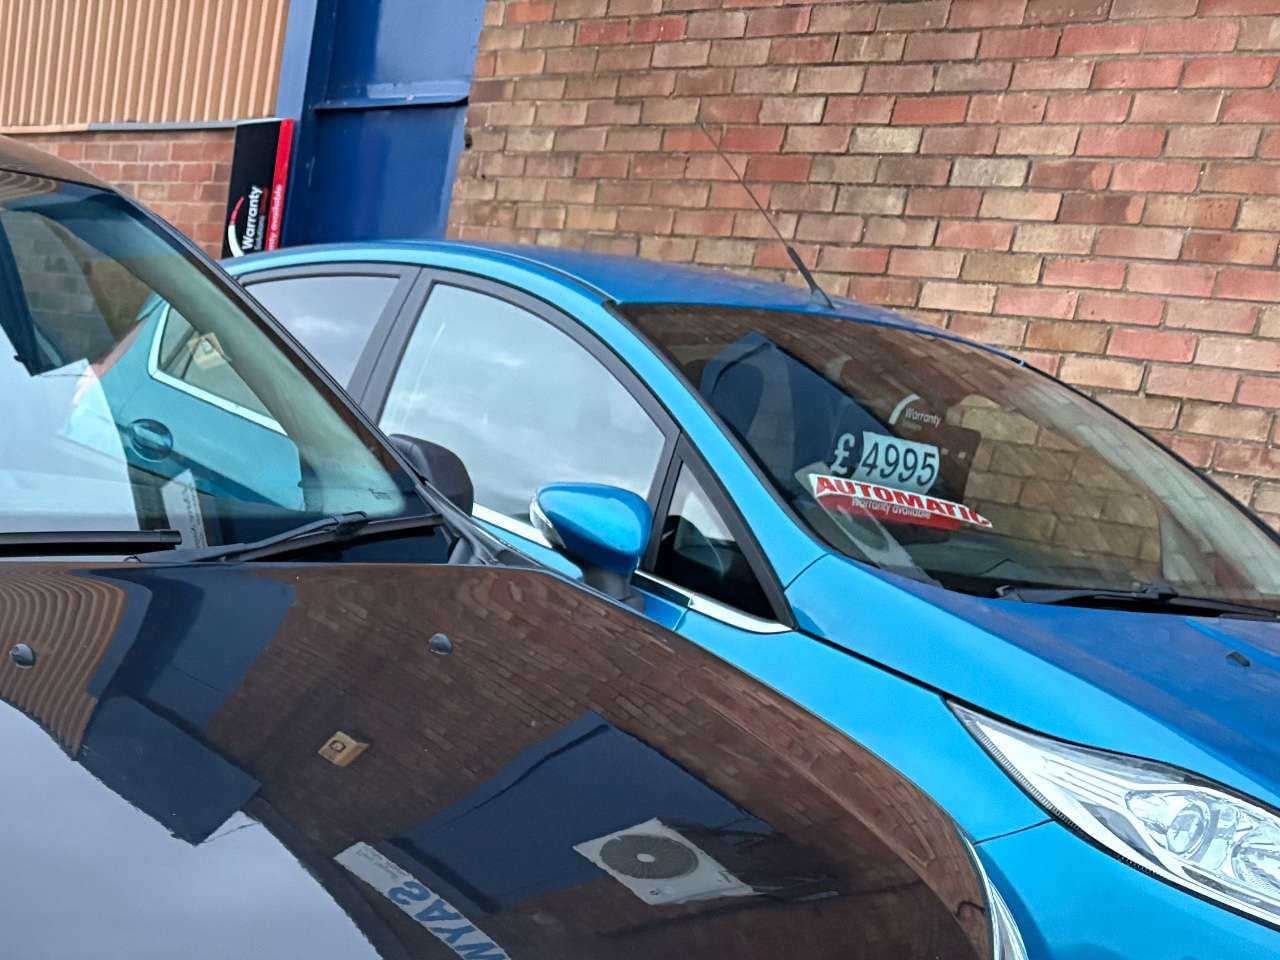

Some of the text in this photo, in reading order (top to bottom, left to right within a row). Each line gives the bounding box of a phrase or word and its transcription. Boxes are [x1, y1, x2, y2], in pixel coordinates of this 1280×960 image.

[241, 185, 263, 250] Warranty
[905, 407, 942, 428] Warranty
[816, 476, 991, 527] AUTOMATIC
